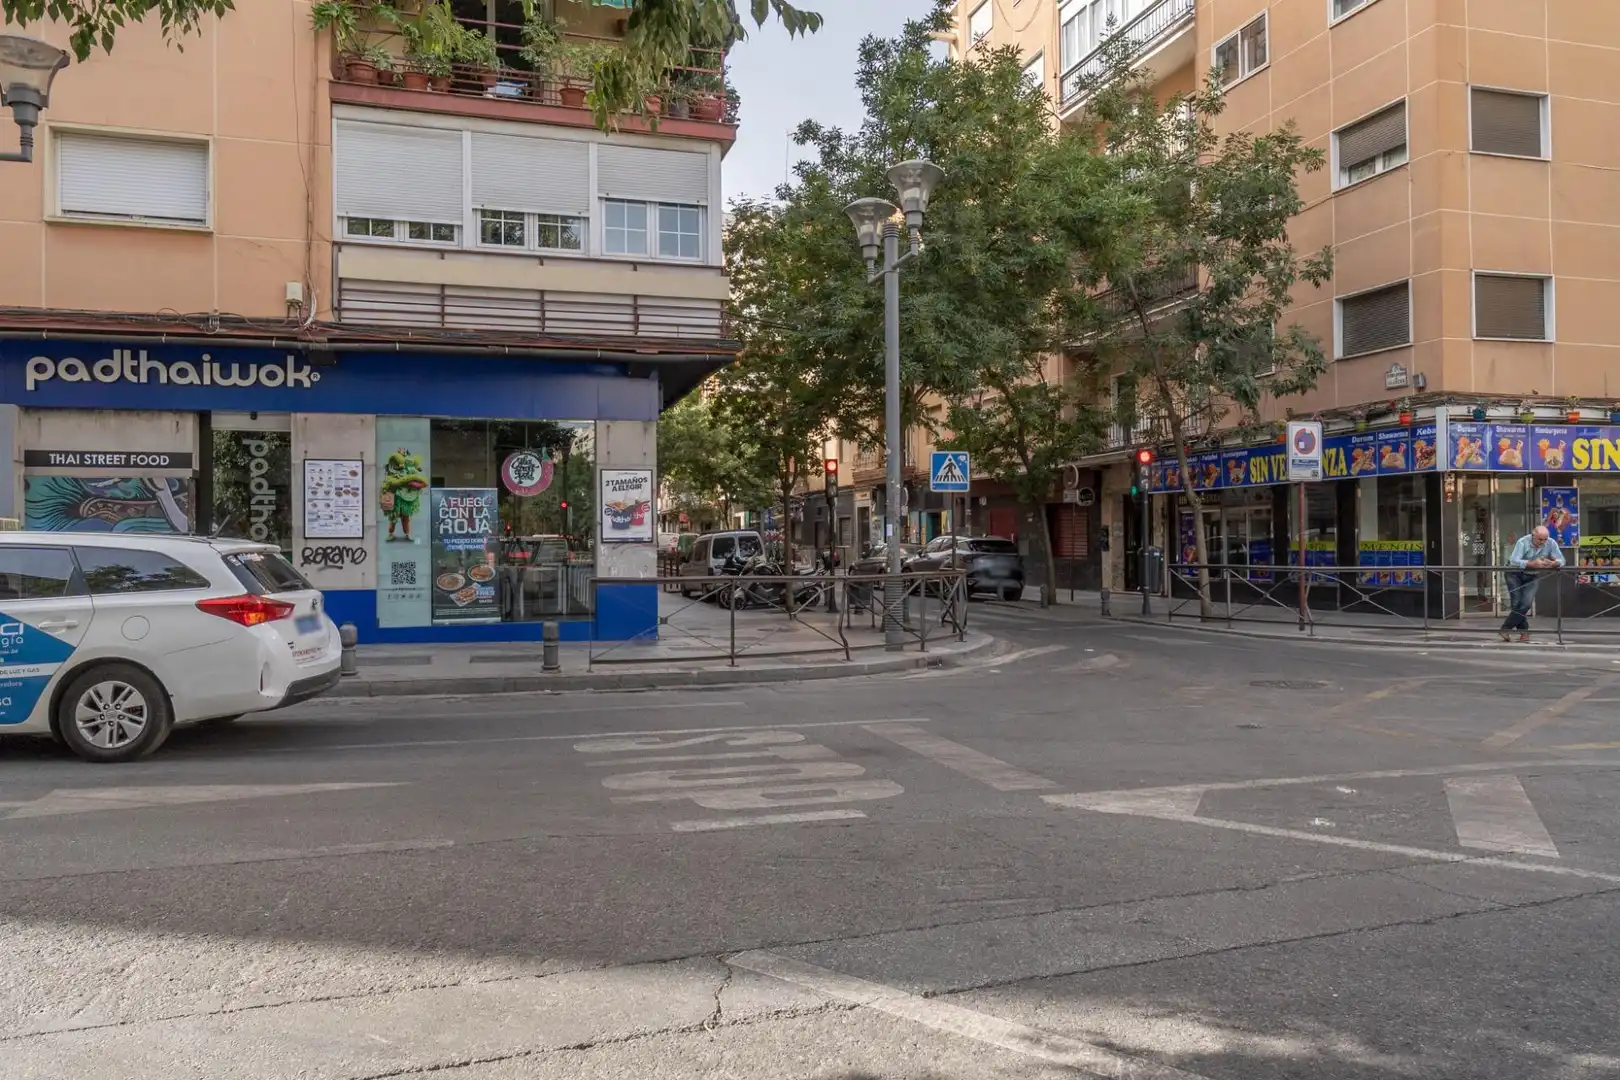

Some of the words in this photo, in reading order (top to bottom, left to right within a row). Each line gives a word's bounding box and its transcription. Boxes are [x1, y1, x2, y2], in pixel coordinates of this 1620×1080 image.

[49, 453, 81, 465] THAI
[83, 454, 129, 466] STREET
[130, 455, 170, 466] FOOD
[1572, 438, 1620, 470] SIN
[439, 497, 448, 508] A
[439, 507, 469, 519] CON
[472, 507, 490, 519] LA
[439, 518, 492, 535] ROJA
